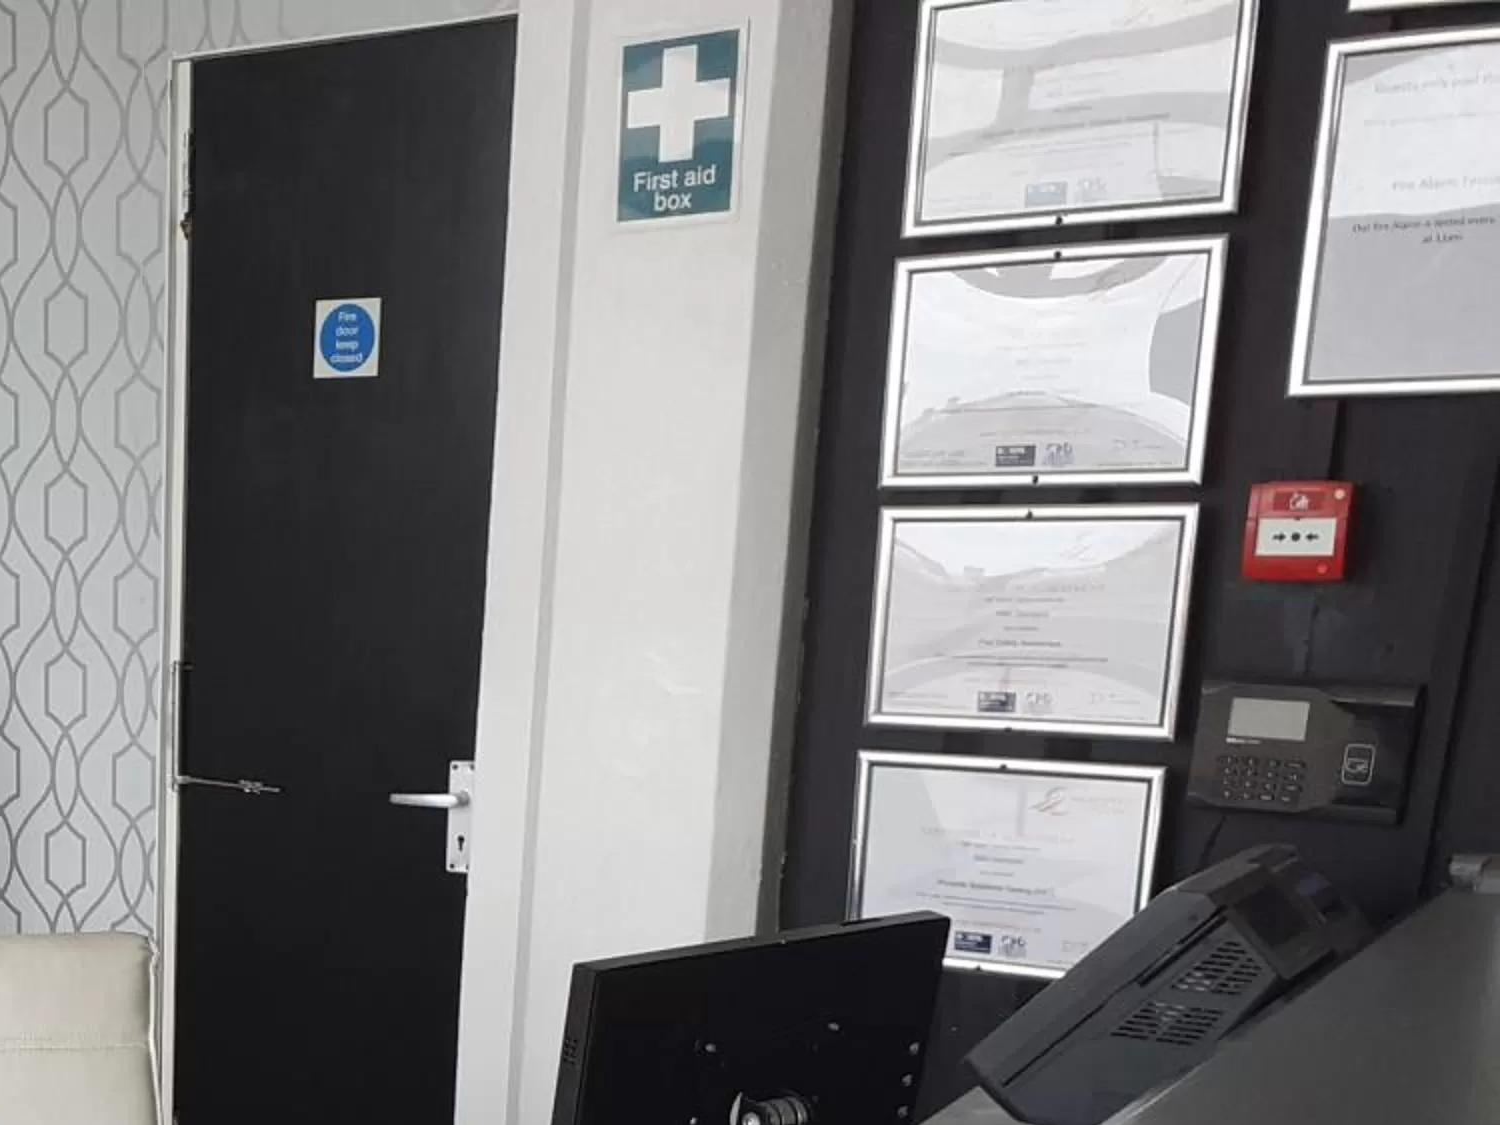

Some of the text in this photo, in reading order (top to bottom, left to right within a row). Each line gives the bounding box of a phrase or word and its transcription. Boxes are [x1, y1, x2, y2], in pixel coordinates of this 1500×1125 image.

[633, 163, 717, 192] First aid
[653, 191, 693, 211] box
[338, 311, 357, 322] Fire
[335, 326, 359, 337] door
[335, 339, 359, 352] keep
[329, 352, 363, 363] closed
